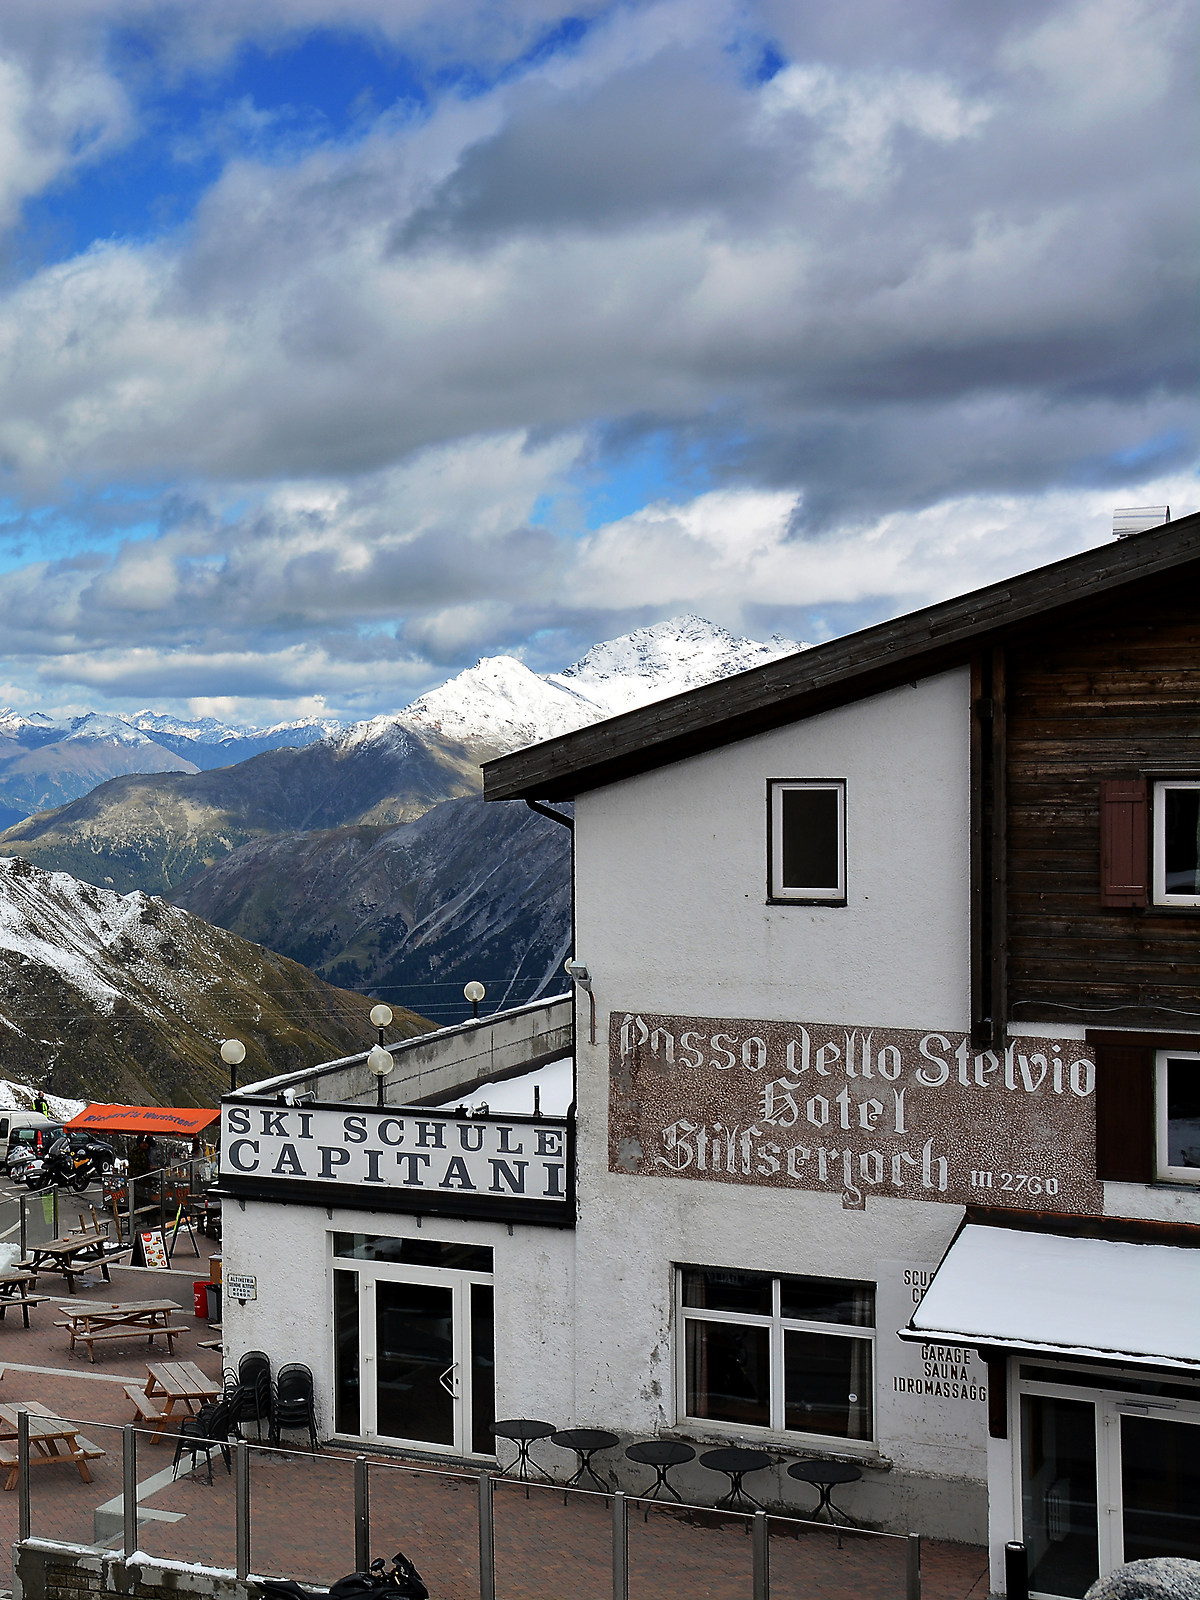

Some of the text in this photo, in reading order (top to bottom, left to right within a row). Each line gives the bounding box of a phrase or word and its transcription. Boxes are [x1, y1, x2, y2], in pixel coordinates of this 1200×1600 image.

[620, 1013, 1097, 1097] Passo dello Stelvio
[84, 1110, 198, 1127] Richard's Wurststand
[758, 1076, 909, 1134] Hotel
[228, 1107, 564, 1158] SKI SCHULE
[227, 1138, 565, 1197] CAPITANI
[654, 1118, 1059, 1204] Stilfserjoch m 2760
[921, 1345, 971, 1364] GARAGE
[924, 1362, 968, 1381] SAUNA
